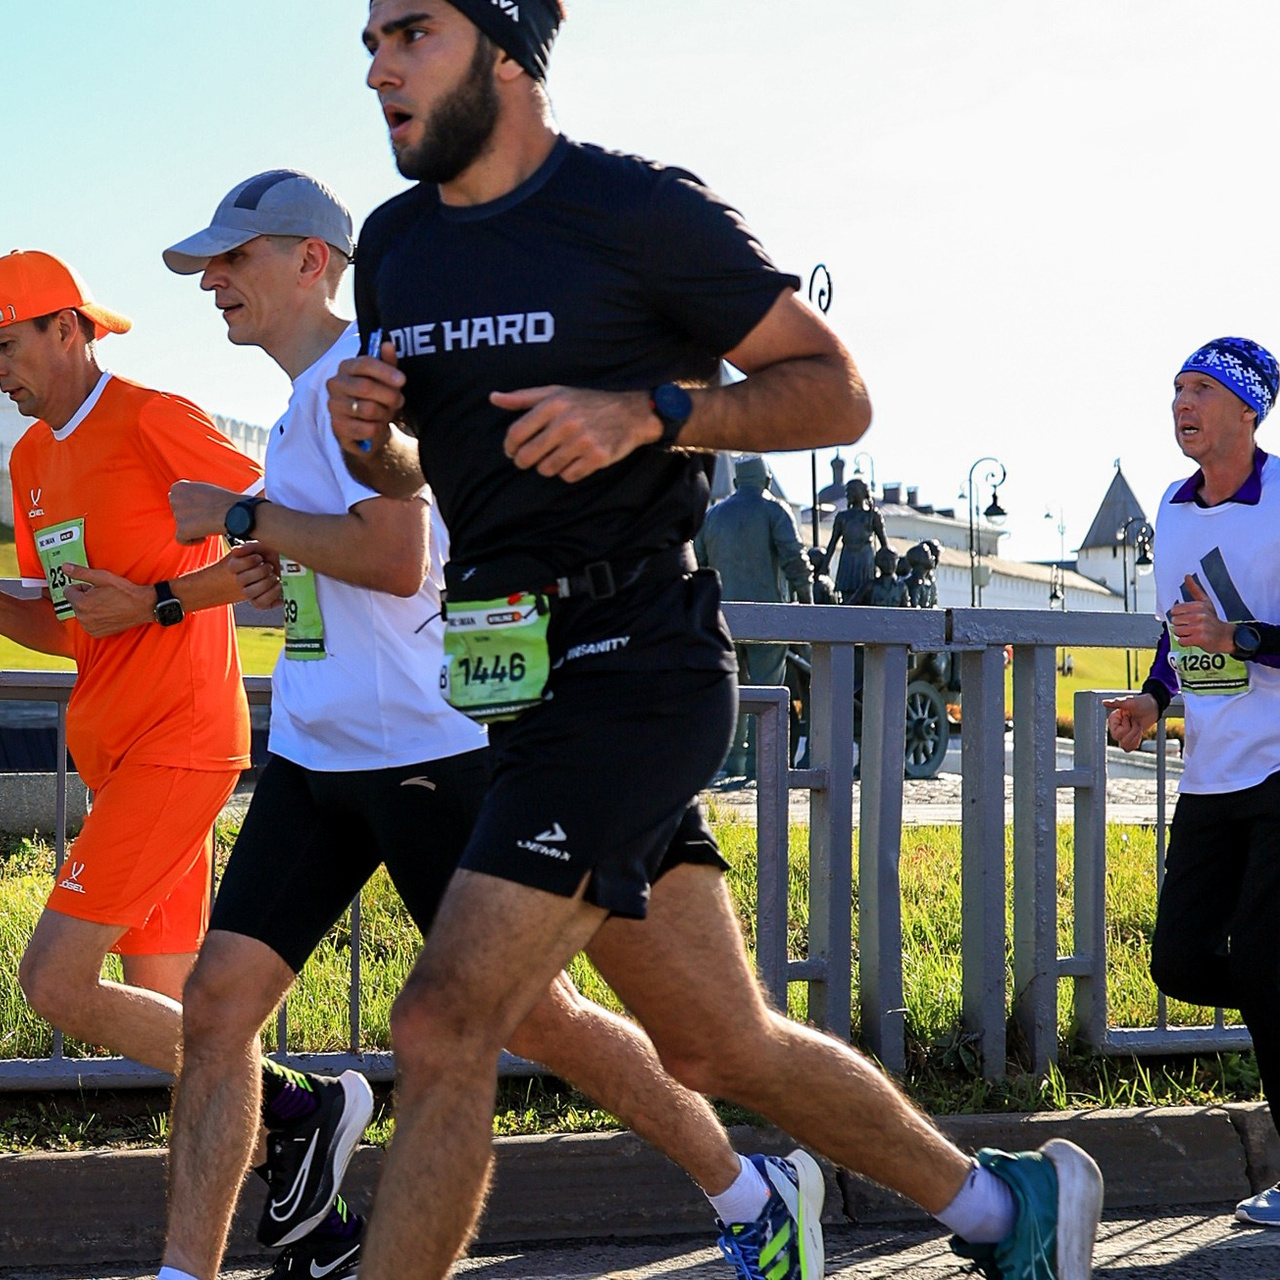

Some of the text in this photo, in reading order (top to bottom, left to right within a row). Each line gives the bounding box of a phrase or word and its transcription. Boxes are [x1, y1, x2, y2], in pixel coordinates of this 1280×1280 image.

[389, 311, 555, 359] DIE HARD
[566, 635, 631, 660] INSANITY
[1181, 653, 1226, 671] 1260
[458, 652, 526, 686] 1446
